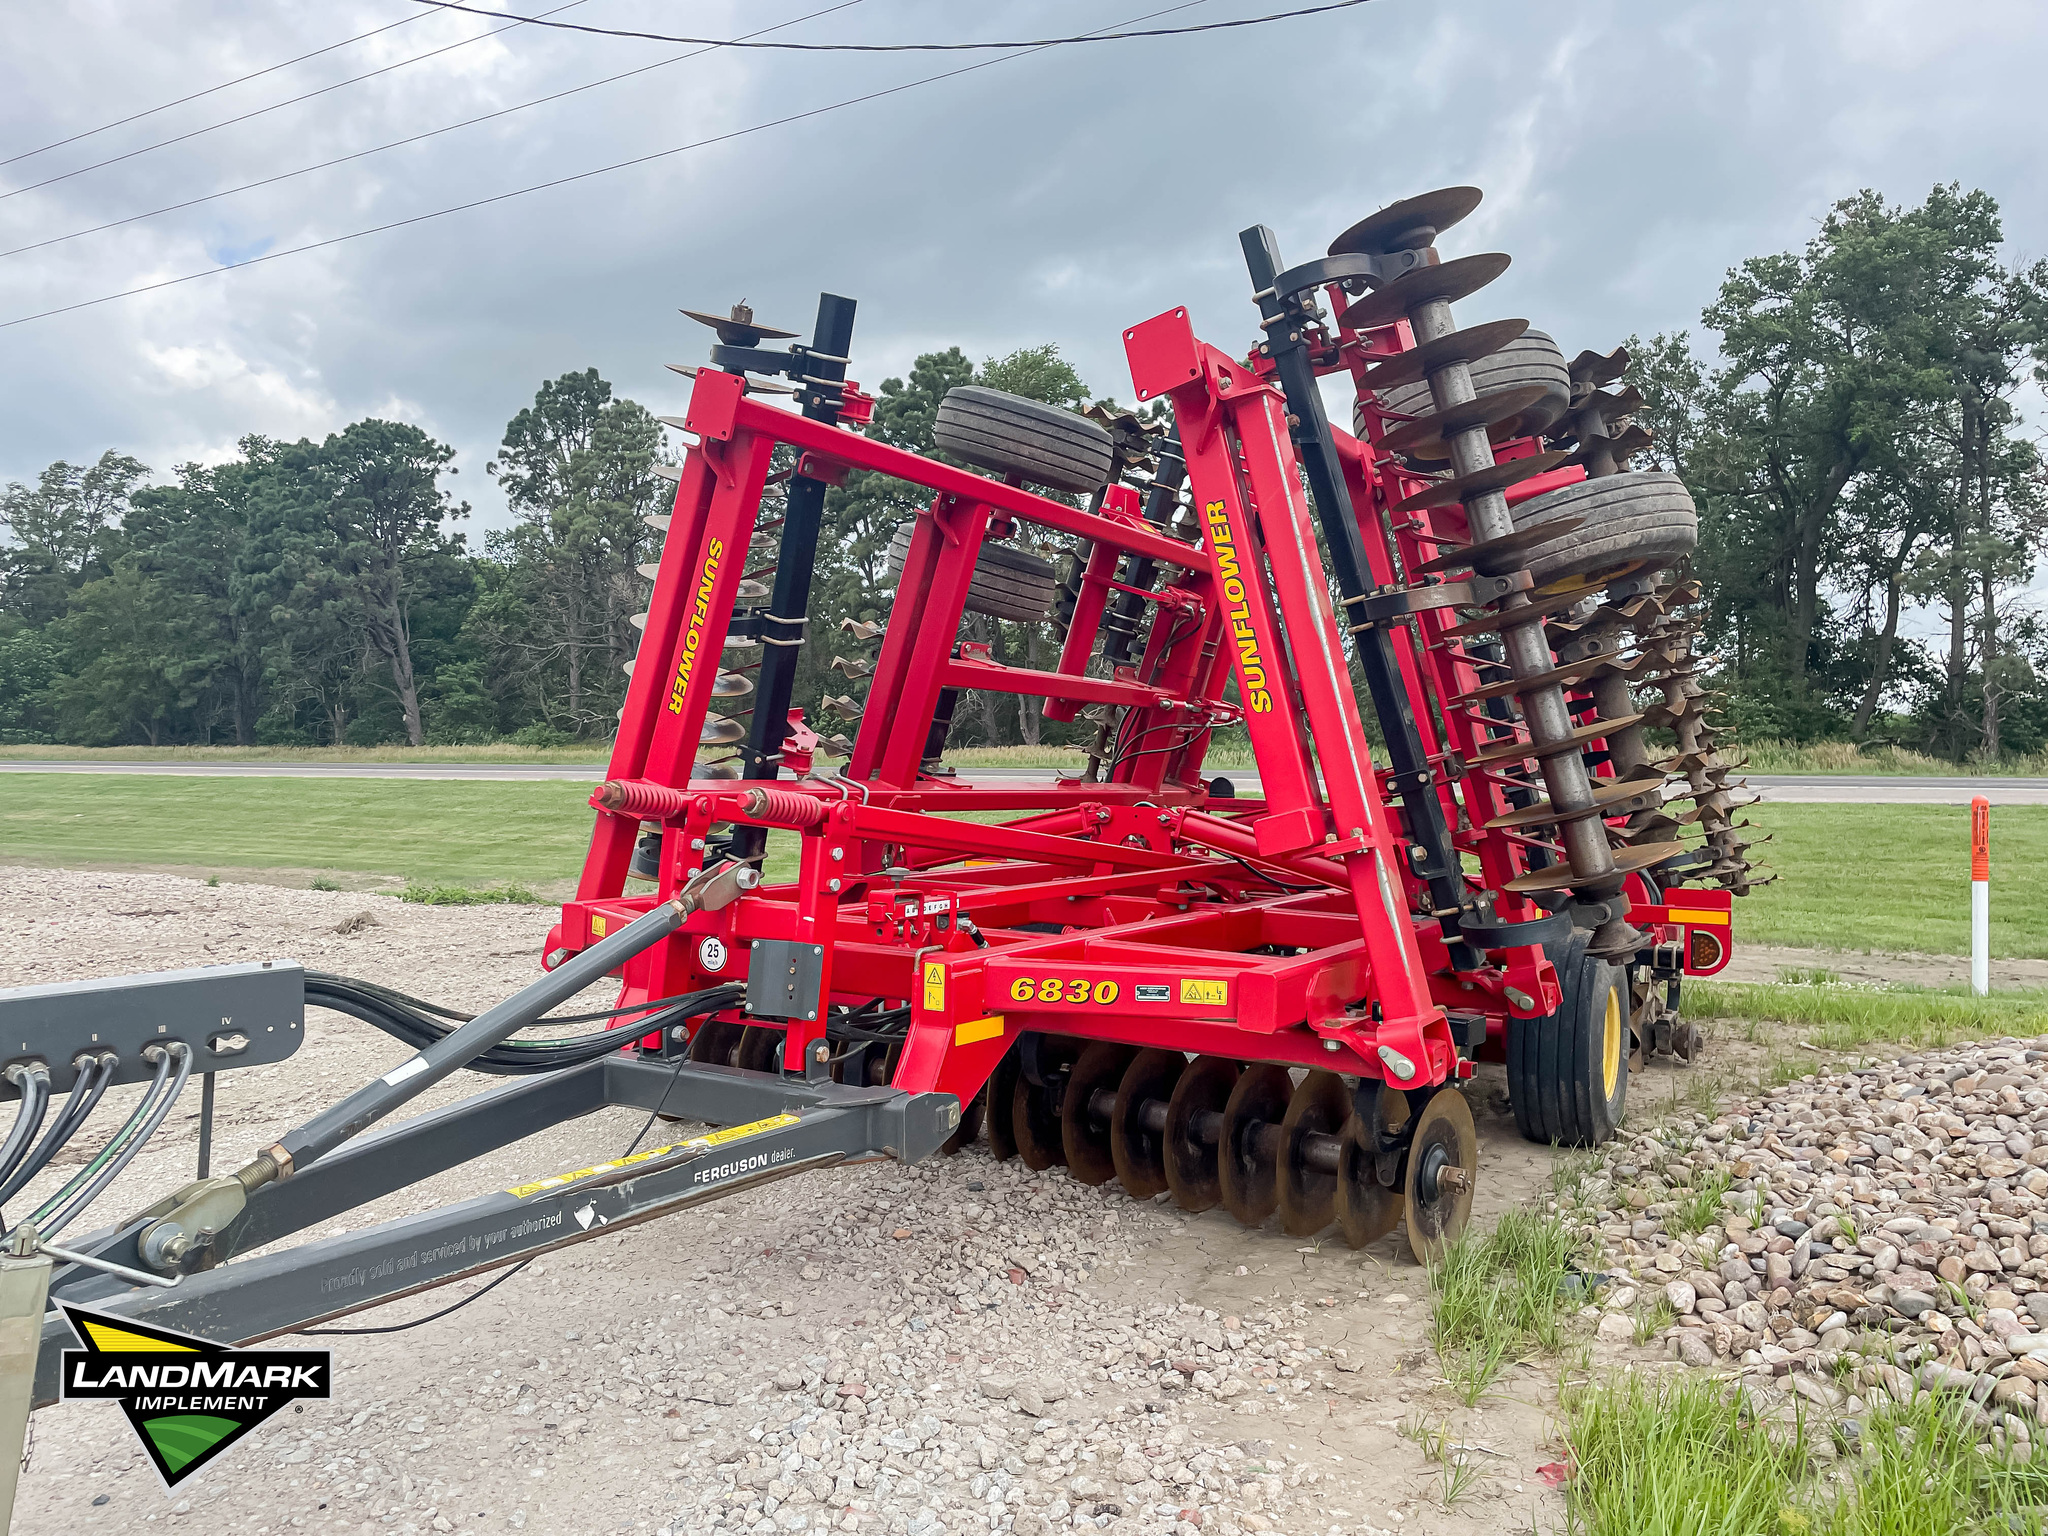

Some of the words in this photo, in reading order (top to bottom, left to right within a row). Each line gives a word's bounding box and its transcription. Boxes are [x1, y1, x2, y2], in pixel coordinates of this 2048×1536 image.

[1205, 499, 1273, 714] SUNFLOWER
[668, 537, 723, 716] SUNFLOWER
[707, 943, 719, 958] 25
[1009, 976, 1120, 1005] 6830
[221, 1016, 232, 1025] IV
[694, 1153, 769, 1184] FERGUSON
[369, 1257, 395, 1279] sold
[396, 1251, 418, 1272] and
[420, 1236, 467, 1264] serviced
[468, 1233, 482, 1252] by
[484, 1228, 508, 1250] your
[509, 1210, 563, 1238] authorized
